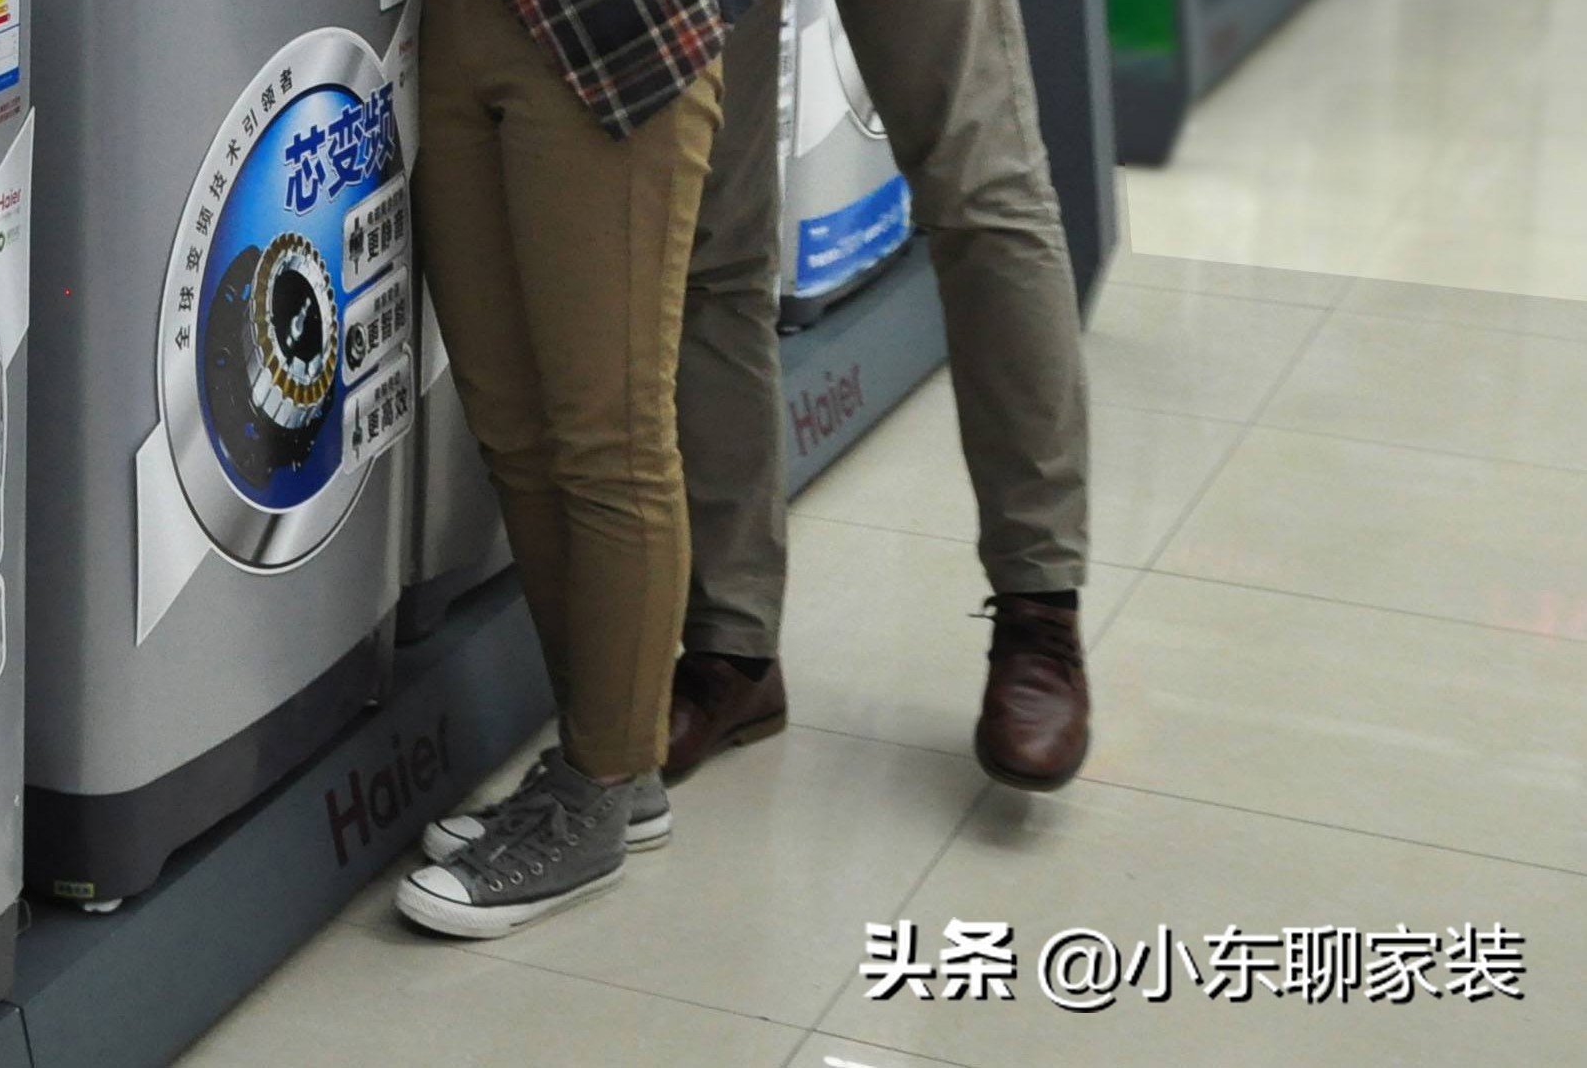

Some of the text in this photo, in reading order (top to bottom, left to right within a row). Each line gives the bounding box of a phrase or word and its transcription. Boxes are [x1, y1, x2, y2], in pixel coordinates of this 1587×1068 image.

[174, 66, 295, 352] 全球变频技术引领者
[284, 81, 395, 215] 芯变频
[789, 363, 865, 458] Haier
[324, 710, 452, 868] Haier
